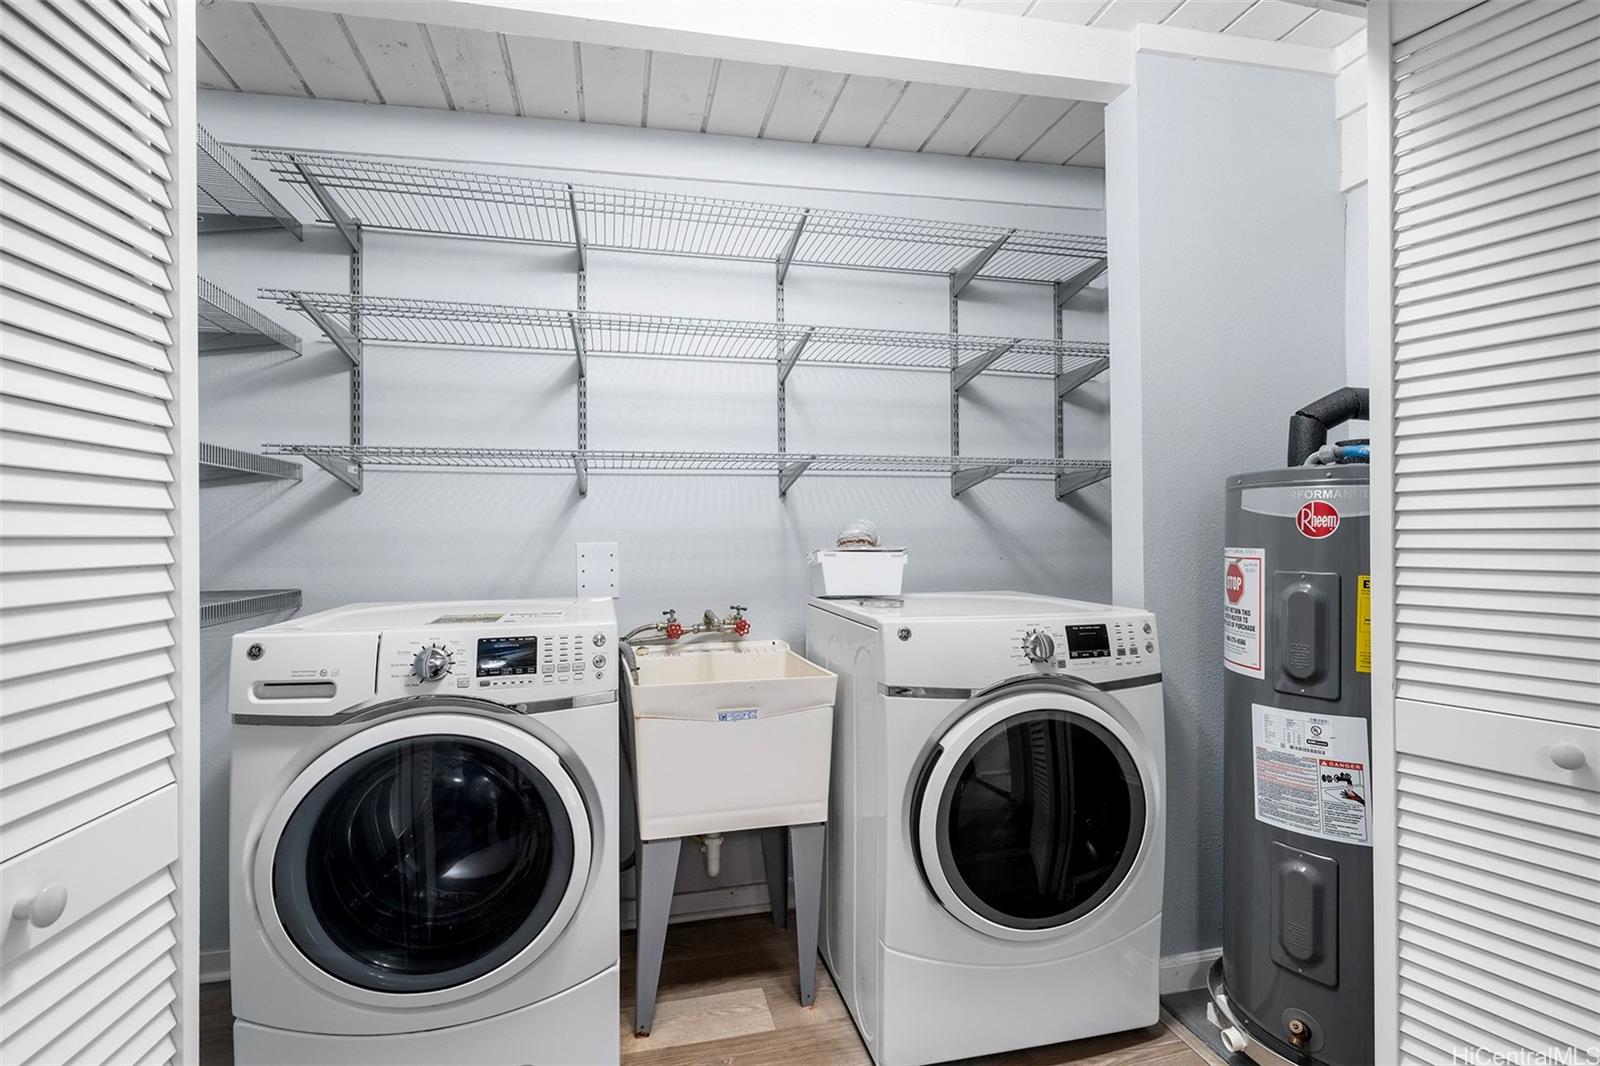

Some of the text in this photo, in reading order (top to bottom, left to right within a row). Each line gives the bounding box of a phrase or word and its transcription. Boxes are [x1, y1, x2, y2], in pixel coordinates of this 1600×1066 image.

[1301, 502, 1337, 533] Rheem
[1226, 576, 1242, 591] STOP
[1241, 608, 1251, 617] THIS
[1235, 622, 1256, 633] PURCHASE
[1328, 761, 1361, 770] DANGER
